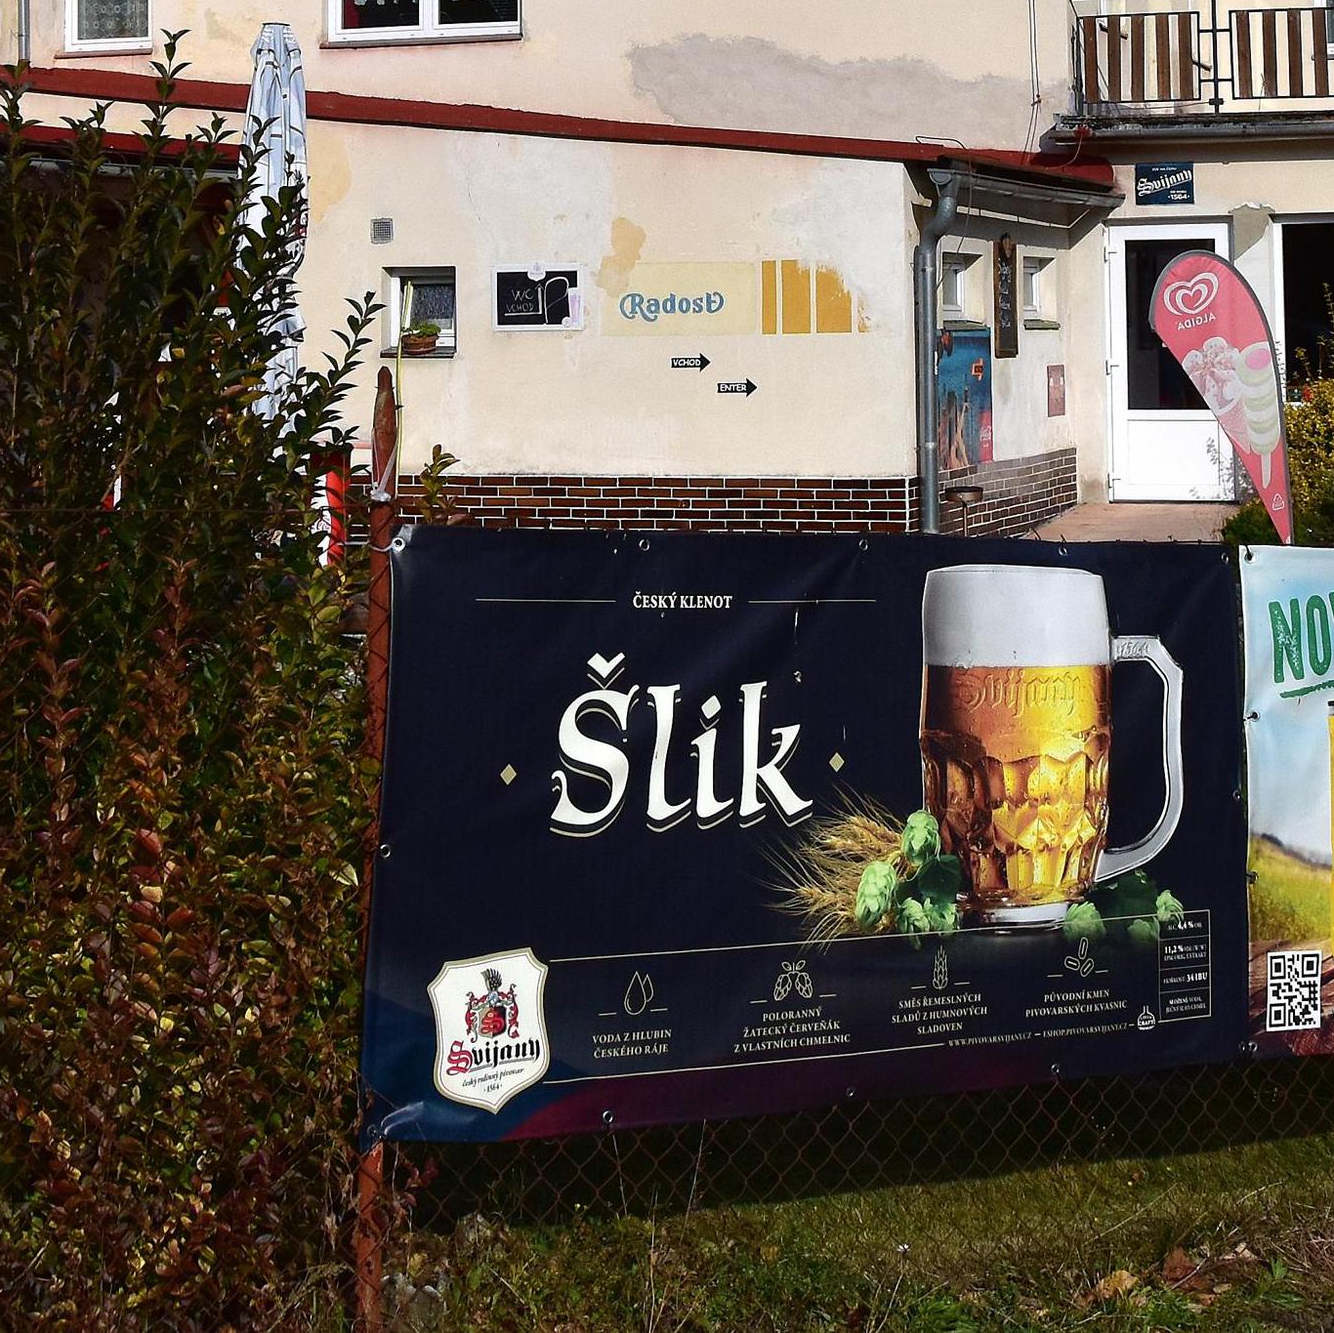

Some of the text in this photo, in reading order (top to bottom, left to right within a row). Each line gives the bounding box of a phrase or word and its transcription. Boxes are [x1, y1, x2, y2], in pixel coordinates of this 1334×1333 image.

[1137, 170, 1192, 197] Svijany
[512, 289, 534, 301] WC
[673, 358, 701, 366] VCHOD
[719, 383, 747, 391] ENTER
[633, 591, 732, 609] ČESKÝ KLENOT
[550, 652, 813, 835] Šlik
[899, 991, 982, 1009] SMĚS ŘEMESLNÝCH
[1044, 988, 1110, 1003] PŮVODNÍ KMEN
[763, 1007, 822, 1022] POLORANNÝ
[892, 1005, 988, 1024] SLADŮ Z HUMNOVÝCH
[1025, 1000, 1128, 1018] PIVOVARSKÝCH KVASNIC
[592, 1029, 672, 1044] VODA Z HLUBIN
[743, 1020, 840, 1038] ŽATECKÝ ČERVEŇÁK
[917, 1021, 963, 1035] SLADOVEN
[593, 1042, 668, 1059] ČESKÉHO RÁJE
[734, 1033, 851, 1053] Z VLASTNÍCH CHMELNIC
[446, 1037, 541, 1076] Svijany
